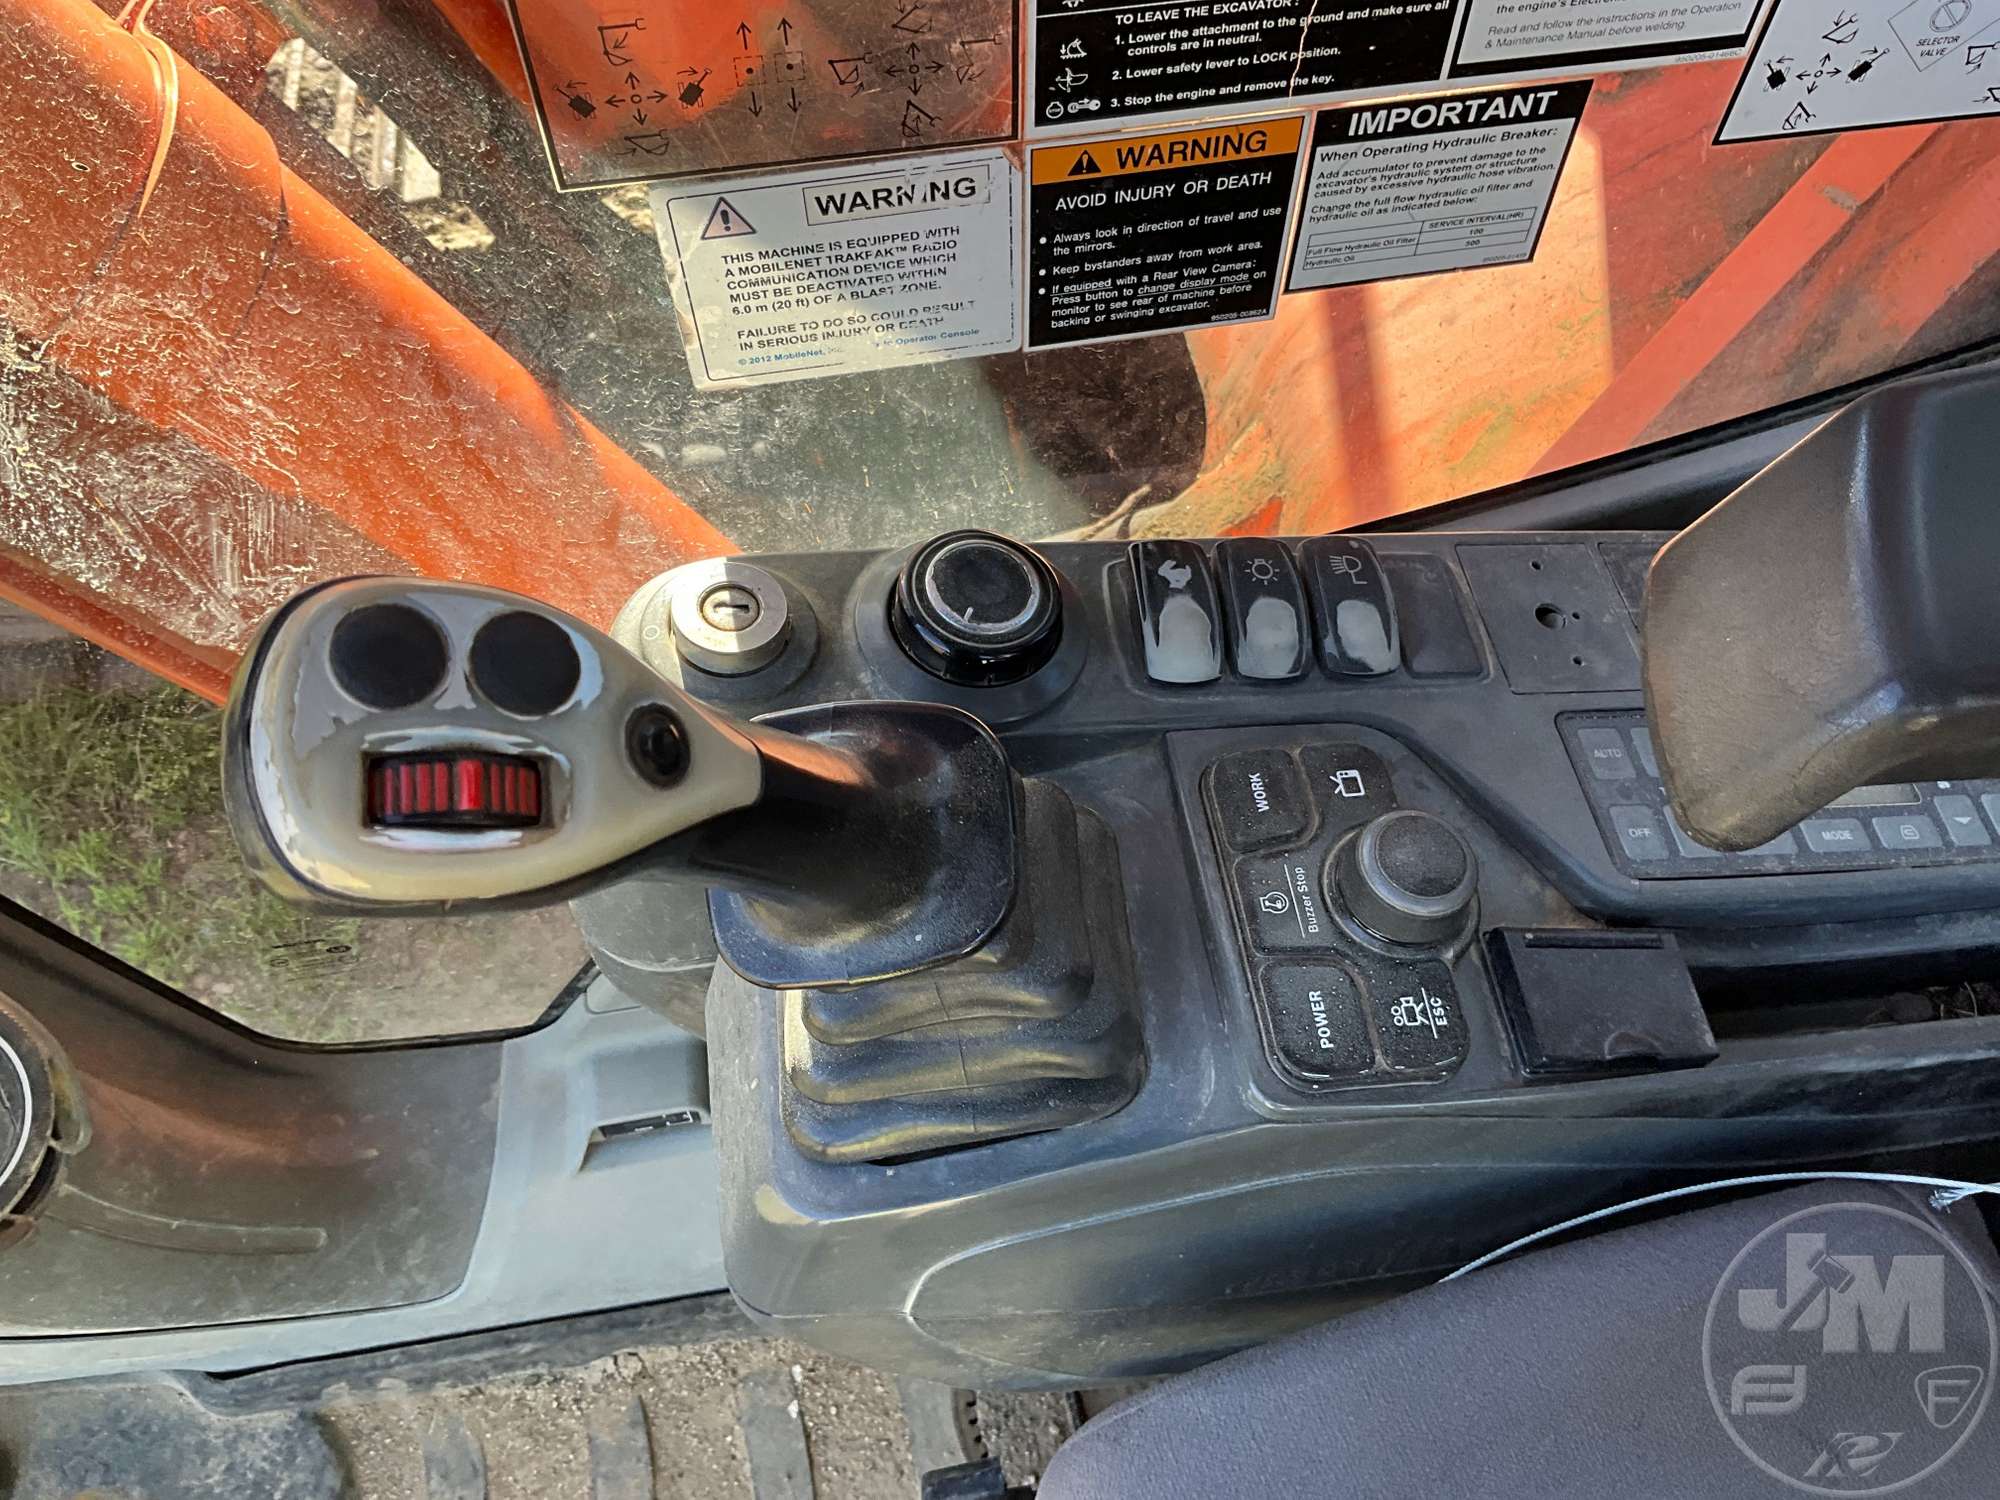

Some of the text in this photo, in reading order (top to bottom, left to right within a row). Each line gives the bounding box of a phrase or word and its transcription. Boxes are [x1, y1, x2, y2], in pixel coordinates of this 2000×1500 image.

[1114, 13, 1134, 26] TO
[1136, 8, 1180, 24] LEAVE
[1183, 5, 1210, 18] THE
[1128, 0, 1450, 44] Lower the attachment the ground and make sure all
[1487, 1, 1742, 36] Read follow instructions Operation
[1517, 0, 1567, 13] engine's
[1127, 31, 1262, 57] controls are neutral.
[1495, 25, 1643, 48] Maintenance Manual before
[1916, 35, 1961, 47] SELECTOR
[1920, 47, 1948, 57] VALVE
[1125, 46, 1341, 79] Lower safety lever LOCK position.
[1124, 74, 1335, 106] Stop the engine and remove the key.
[1348, 90, 1559, 137] IMPORTANT
[1116, 129, 1268, 170] WARNING
[1320, 127, 1558, 163] When Operating Hydraulic Breaker:
[1316, 146, 1547, 181] Add accumulator prevent damage the
[1379, 168, 1431, 183] hydraulic
[1432, 164, 1473, 177] system
[1488, 156, 1538, 169] structure
[1055, 170, 1272, 211] AVOID INJURY OR DEATH
[1311, 178, 1535, 214] Change the full flow hydraulic oil filter and
[1313, 186, 1353, 199] caused
[1370, 179, 1425, 192] excessive
[1426, 171, 1477, 186] hydraulic
[1477, 169, 1506, 179] hose
[1053, 207, 1282, 244] Always look direction travel and use
[1308, 196, 1479, 224] hydraulic oil indicated below:
[720, 251, 755, 265] THIS
[757, 242, 826, 261] MACHINE
[828, 240, 843, 252] IS
[846, 230, 921, 250] EQUIPPED
[1052, 241, 1263, 276] Keep bystanders away from work area.
[1053, 241, 1116, 257] the mirrors.
[726, 266, 850, 291] COMMUNICATION
[853, 258, 906, 275] DEVICE
[737, 256, 823, 277] MOBILENET
[1063, 259, 1257, 294] equipped with Rear View Camera:
[729, 289, 769, 304] MUST
[772, 286, 793, 298] BE
[1051, 271, 1250, 306] Press button change display mode
[1051, 283, 1253, 317] monitor see rear of machine before
[731, 304, 752, 316] 6.0
[794, 297, 810, 308] ft)
[812, 294, 833, 305] OF
[1050, 300, 1211, 329] backing or swinging excavator.
[739, 341, 754, 352] IN
[756, 332, 819, 349] SERIOUS
[874, 322, 896, 334] OR
[1249, 772, 1270, 813] WORK
[1628, 828, 1651, 838] OFF
[1821, 830, 1854, 841] MODE
[1294, 867, 1319, 933] Buzzer Stop
[1309, 990, 1334, 1049] POWER
[1433, 996, 1448, 1027] ESC
